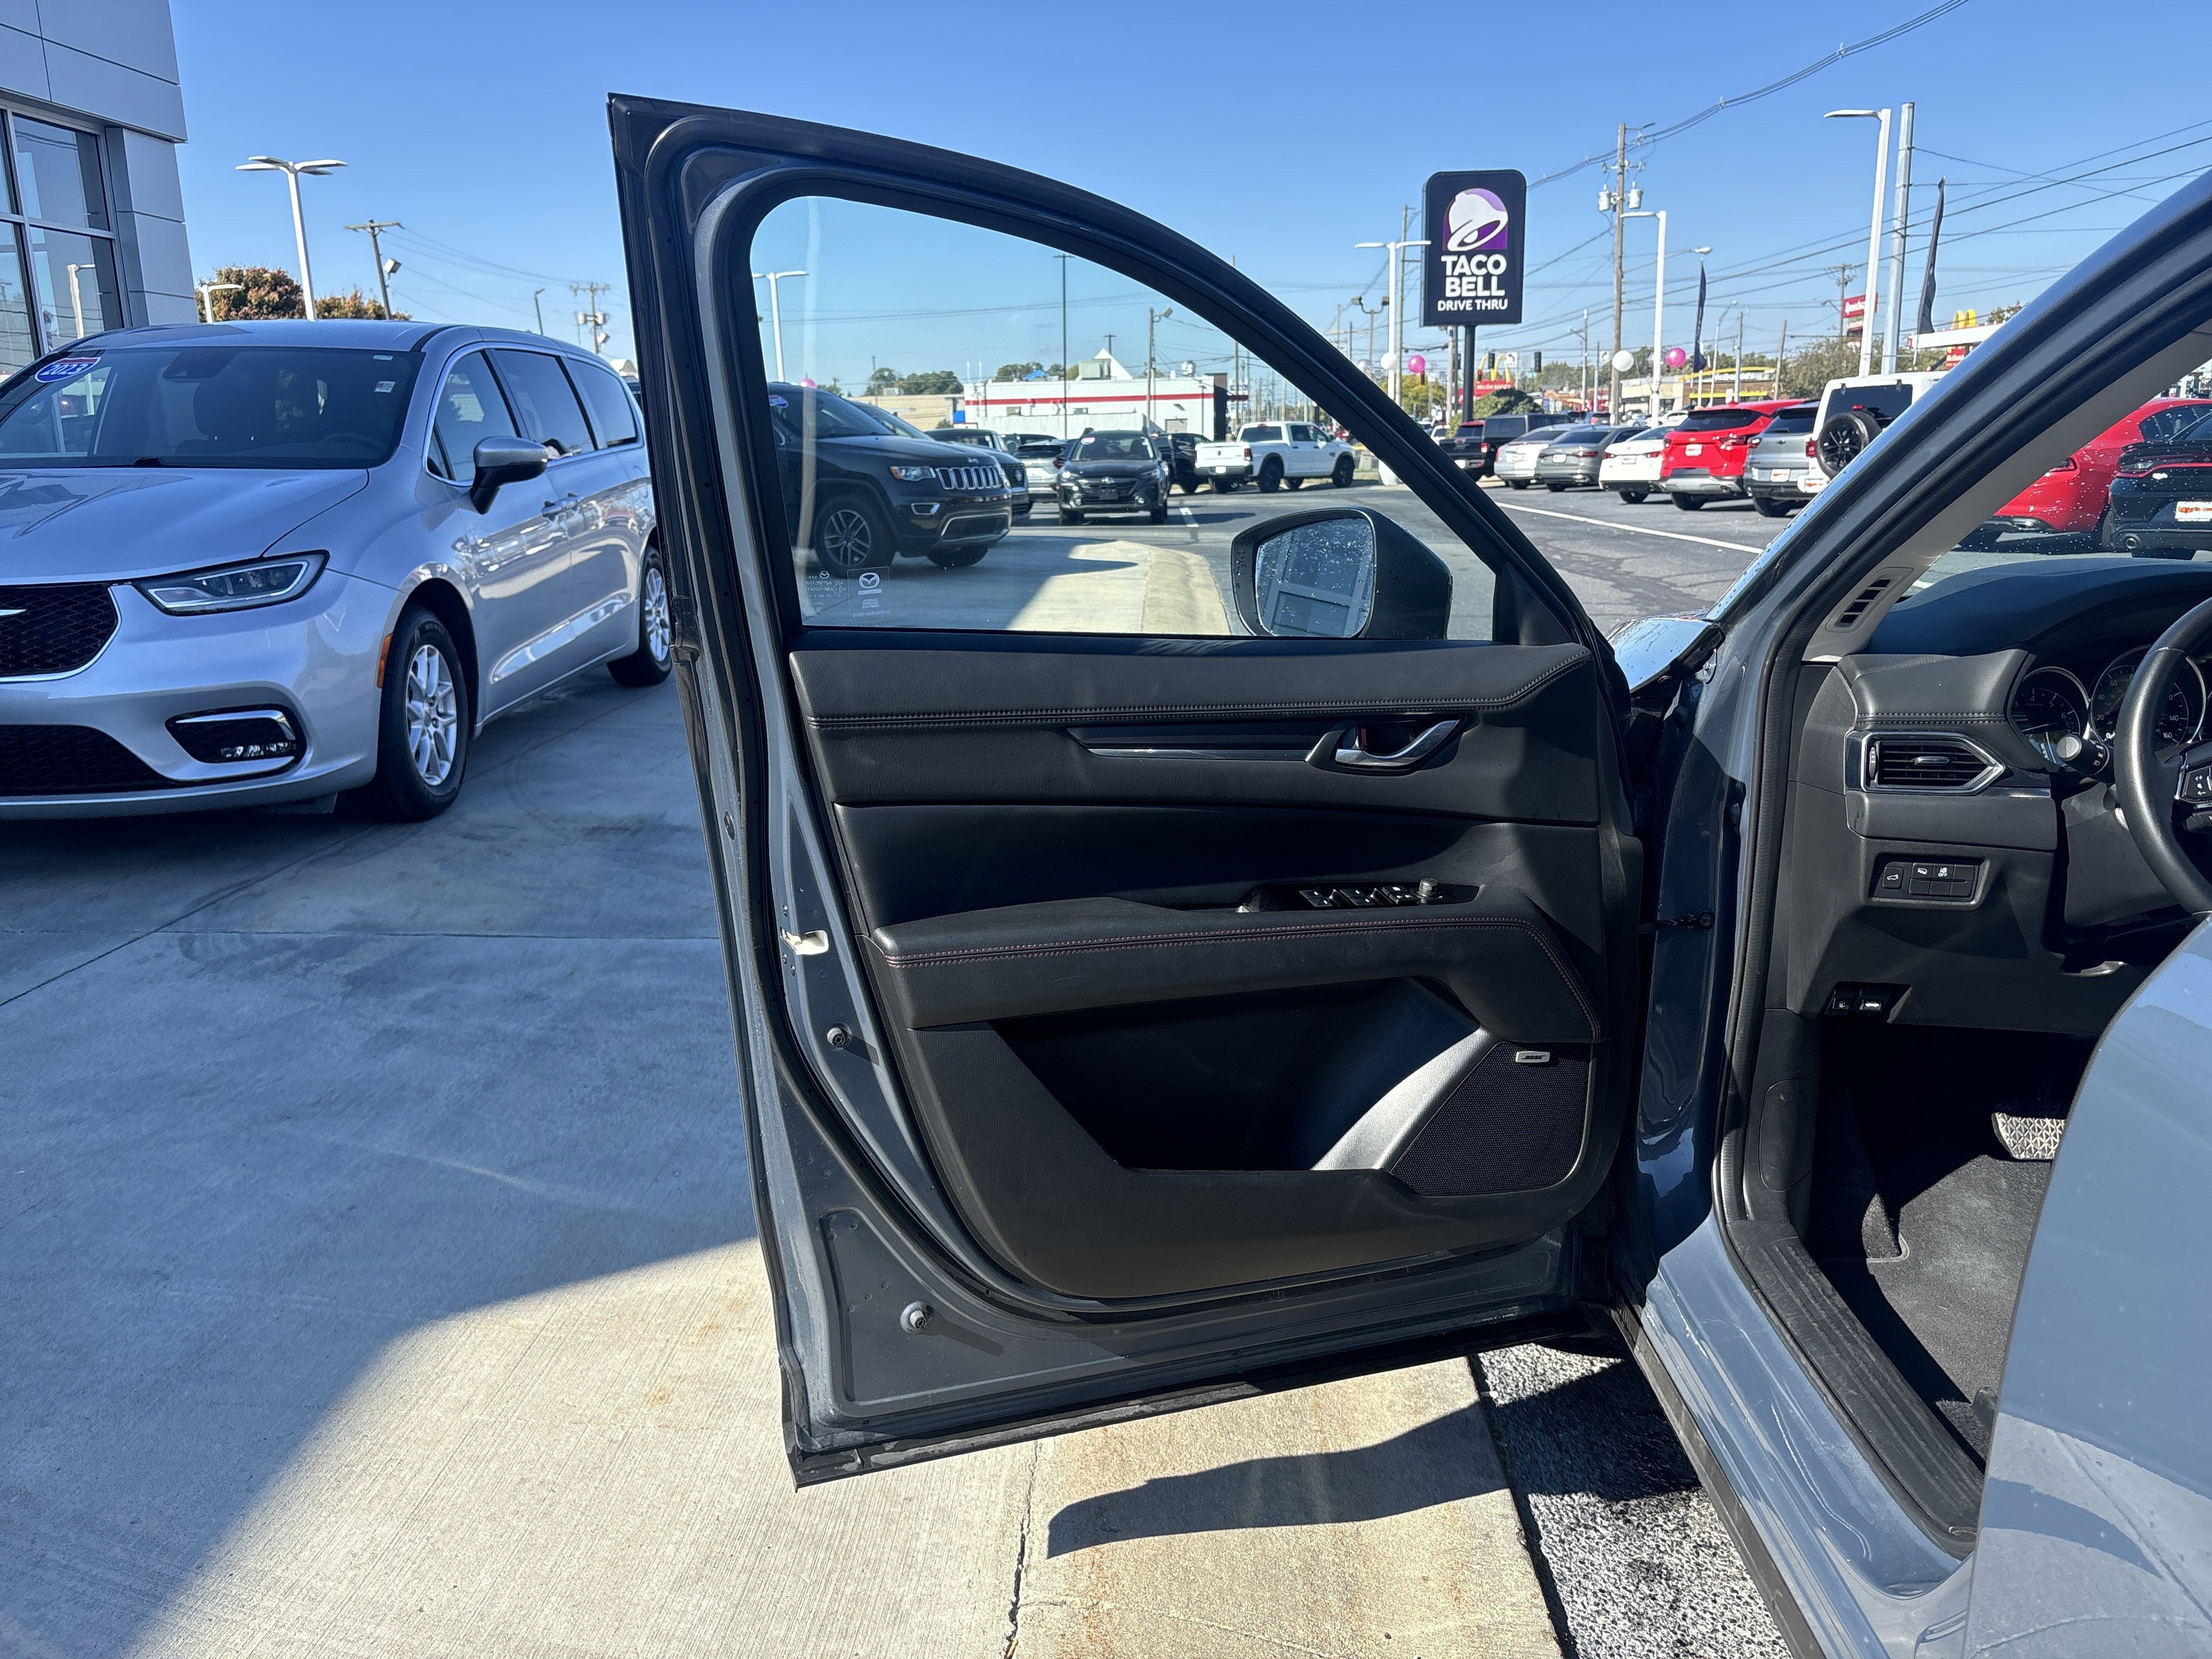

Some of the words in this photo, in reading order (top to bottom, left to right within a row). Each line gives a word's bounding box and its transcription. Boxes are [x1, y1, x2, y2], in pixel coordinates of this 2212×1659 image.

[1441, 253, 1507, 276] TACO
[1445, 275, 1505, 297] BELL
[1437, 299, 1474, 311] DRIVE
[1475, 298, 1508, 311] THRU
[39, 363, 89, 376] 2023
